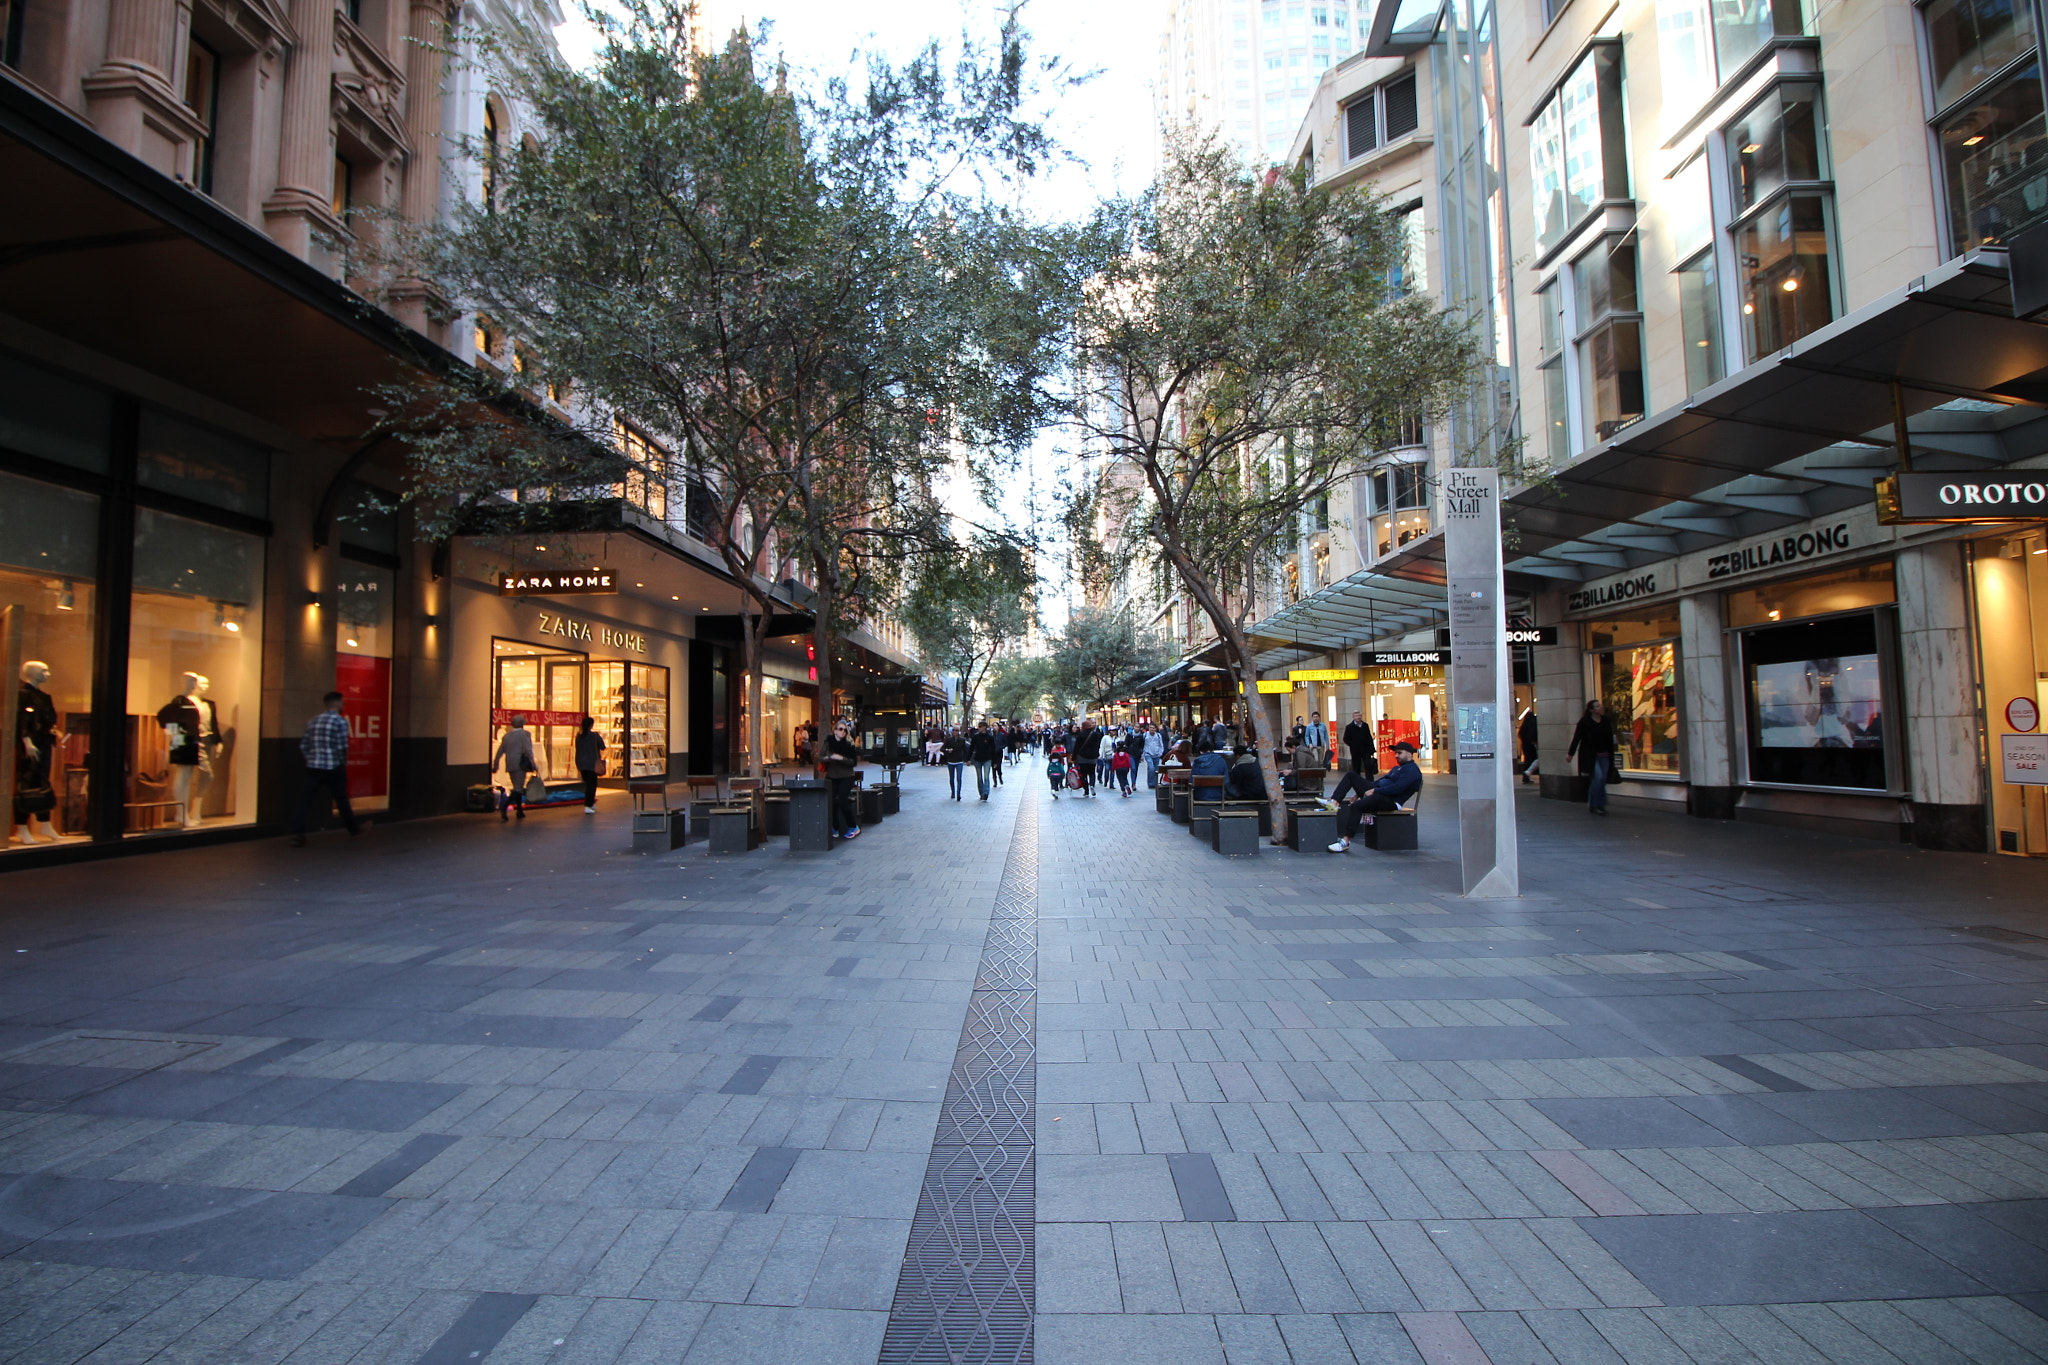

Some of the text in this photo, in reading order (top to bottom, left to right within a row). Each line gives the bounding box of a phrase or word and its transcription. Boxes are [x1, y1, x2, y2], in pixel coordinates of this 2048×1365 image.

[1451, 472, 1476, 487] Pitt
[1447, 485, 1488, 498] Street
[1448, 499, 1480, 513] Mall
[1730, 523, 1850, 574] BILLABONG
[505, 576, 611, 589] ZARA HOME
[1583, 574, 1656, 608] BILLABONG
[540, 613, 646, 653] ZARA HOME
[1387, 653, 1440, 662] BILLABONG
[1301, 670, 1347, 680] FOREVER 21
[1379, 665, 1433, 679] FOREVER 21
[493, 710, 511, 724] SALE
[544, 712, 560, 724] SALE
[345, 715, 380, 738] ALE
[2006, 752, 2046, 761] SEASON
[2016, 762, 2037, 770] SALE
